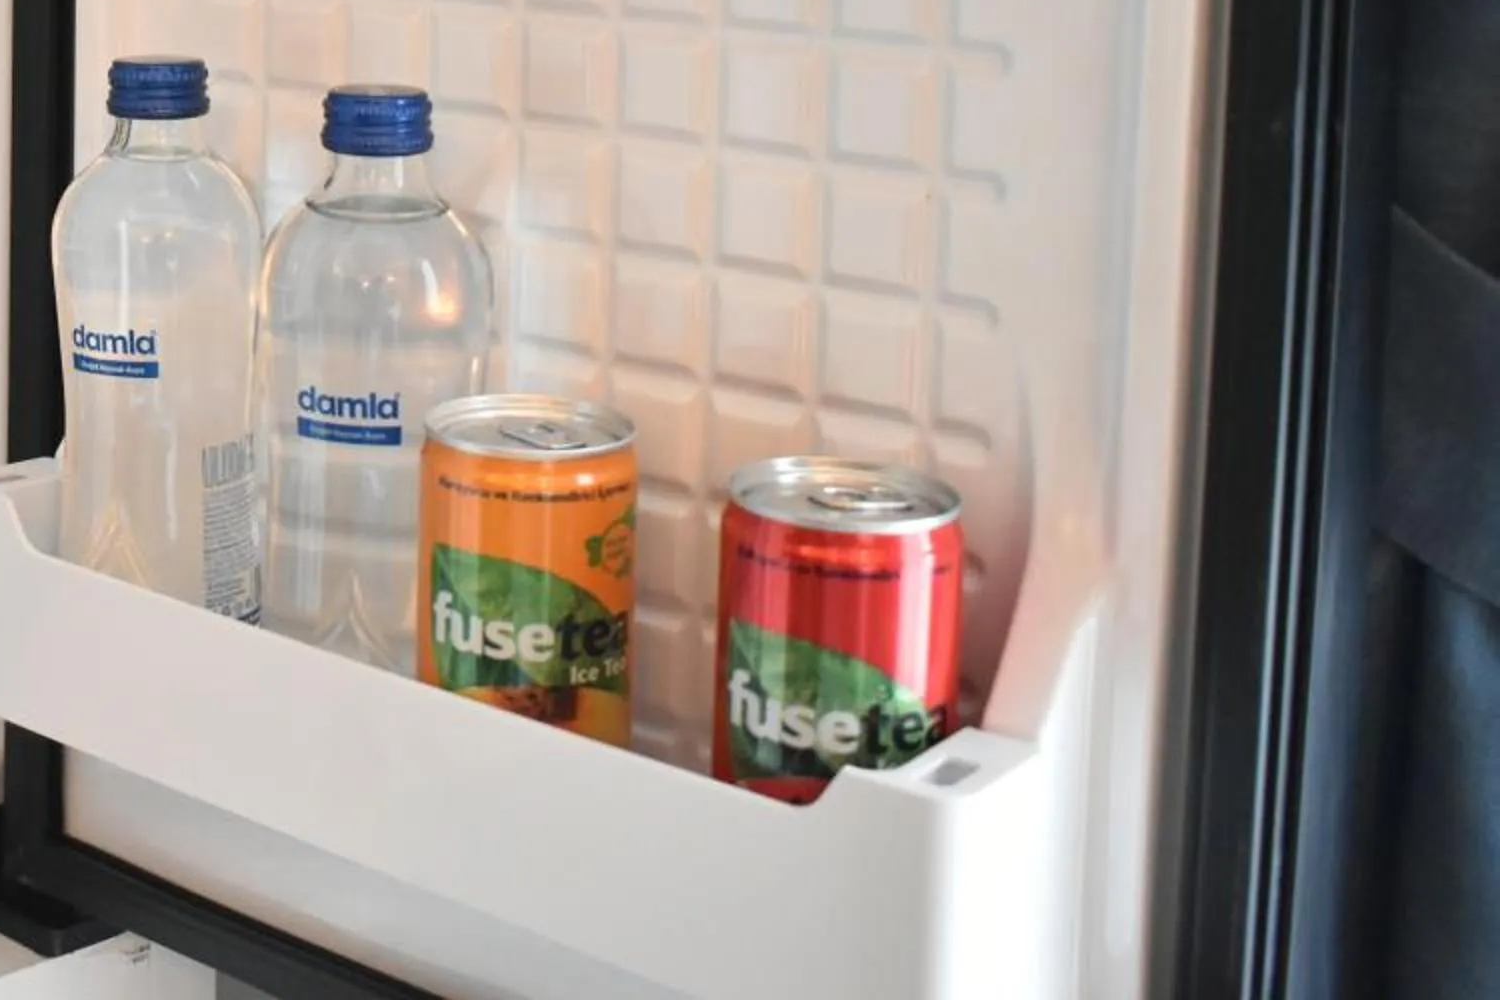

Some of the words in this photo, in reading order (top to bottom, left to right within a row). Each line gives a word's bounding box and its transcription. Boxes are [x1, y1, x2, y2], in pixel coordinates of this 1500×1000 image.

[73, 324, 156, 355] damla
[298, 385, 400, 420] damla
[568, 664, 600, 686] Ice
